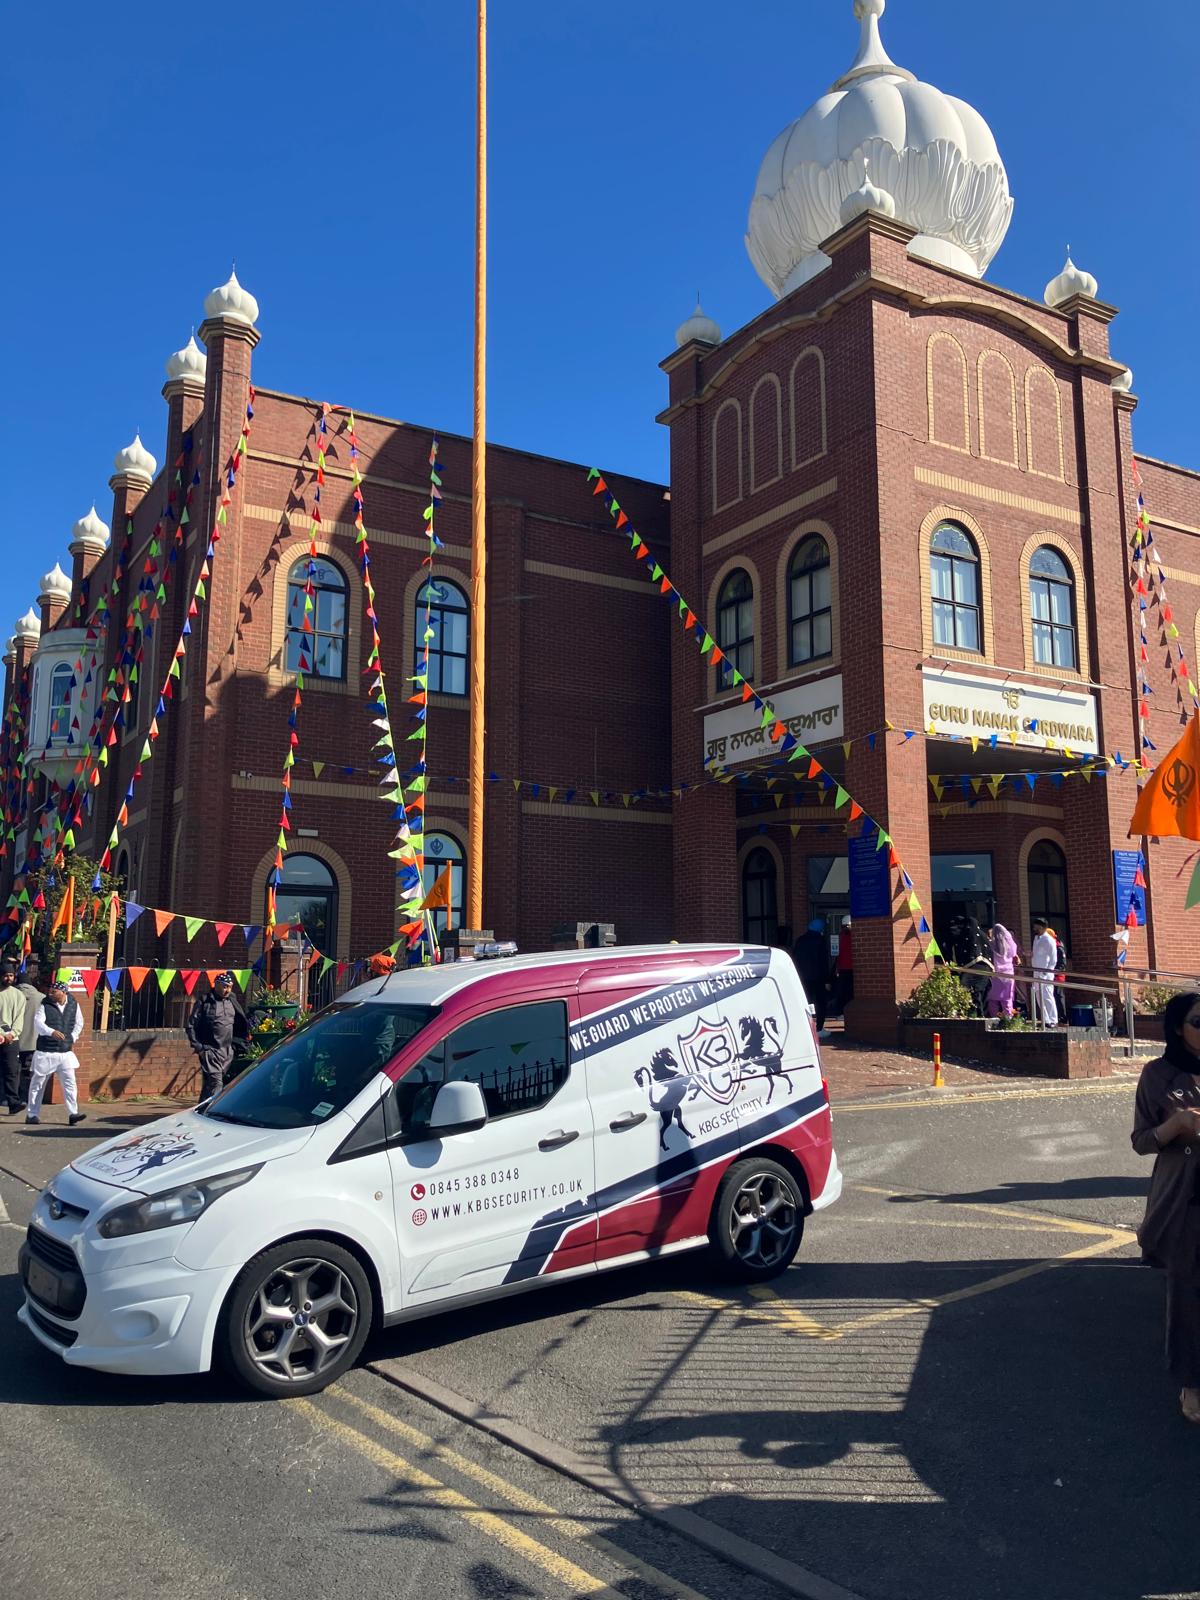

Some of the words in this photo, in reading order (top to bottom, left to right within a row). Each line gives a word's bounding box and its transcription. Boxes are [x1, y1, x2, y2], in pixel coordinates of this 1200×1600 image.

[929, 702, 970, 725] GURU
[972, 709, 1019, 731] NANAK
[730, 726, 766, 751] ਨਾਨਕ
[570, 1028, 592, 1052] WE
[589, 1013, 630, 1043] GUARD
[630, 1004, 651, 1026] WE
[649, 985, 699, 1020] PROTECT
[696, 978, 717, 997] WE
[715, 963, 757, 990] SECURE
[699, 1116, 720, 1136] KBG
[719, 1096, 764, 1126] SECURITY
[429, 1178, 461, 1196] 0845
[464, 1174, 487, 1190] 388
[490, 1167, 520, 1185] 0348
[431, 1179, 583, 1221] WWW.KBGSECURITY.CO.UK
